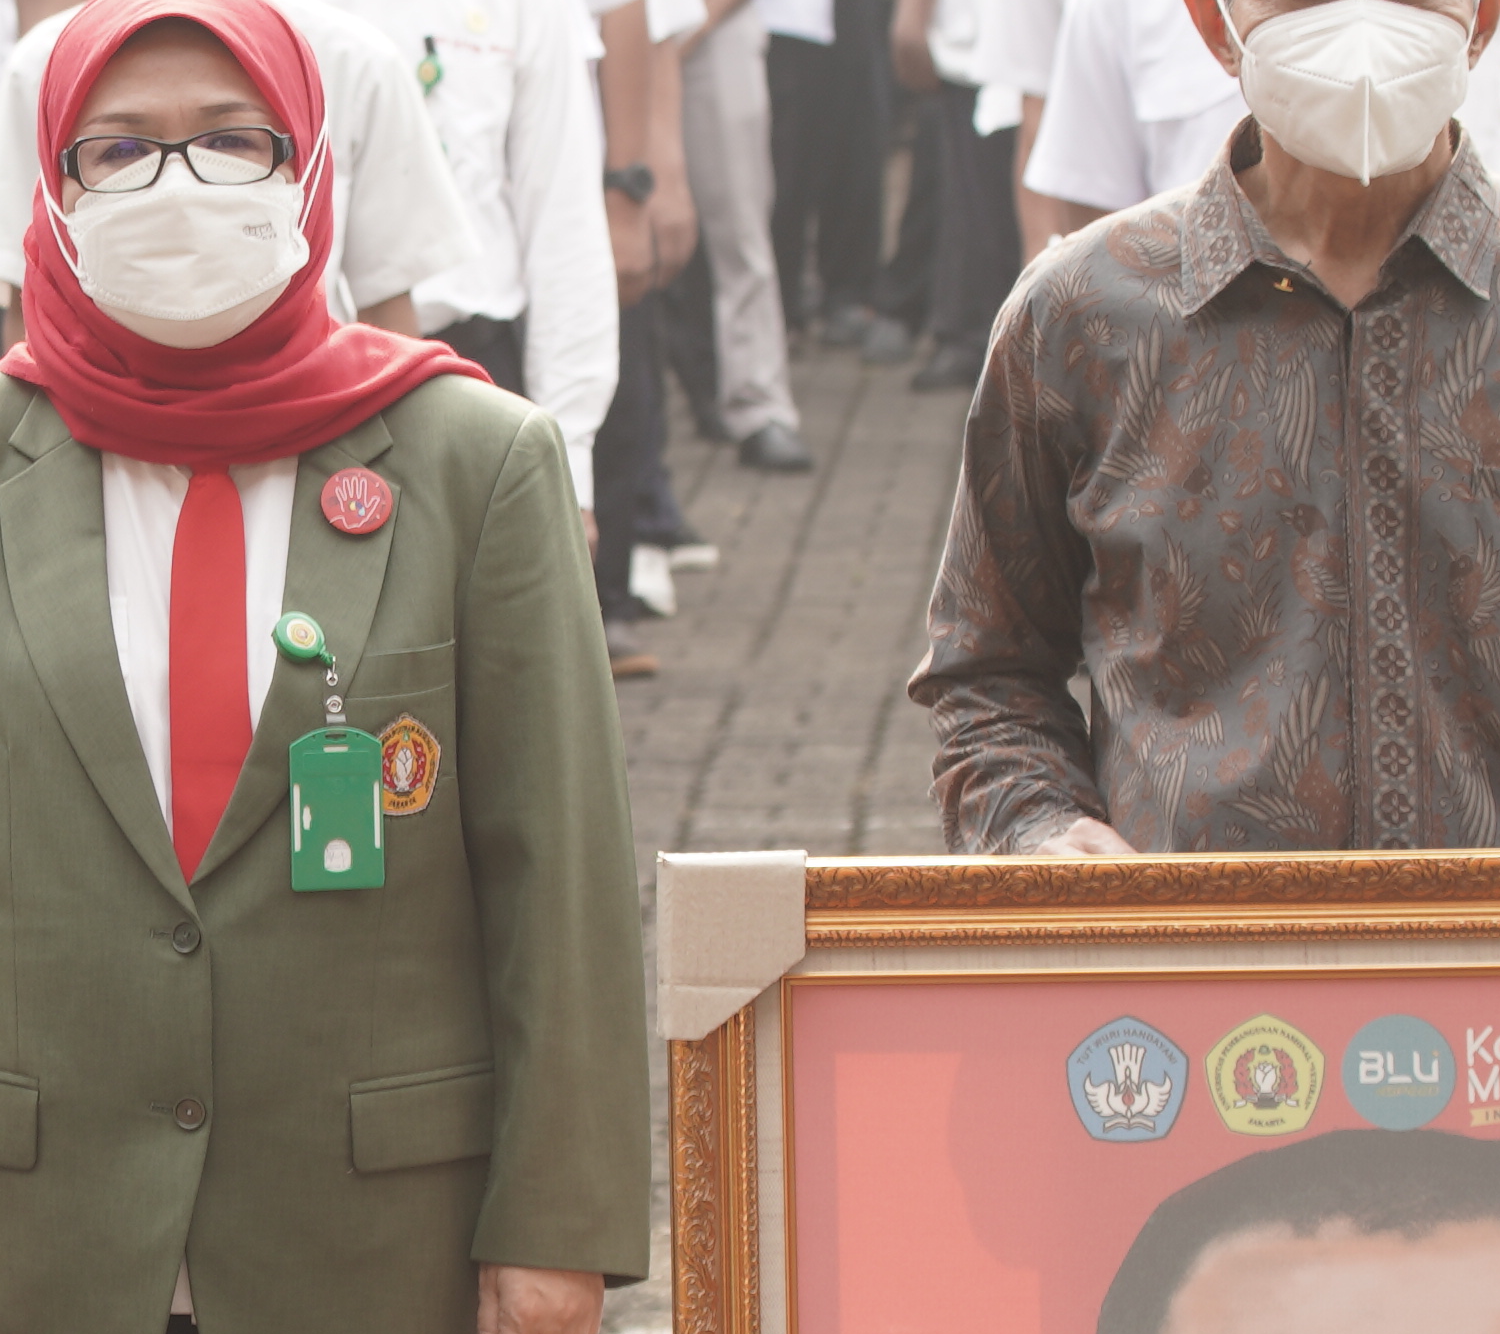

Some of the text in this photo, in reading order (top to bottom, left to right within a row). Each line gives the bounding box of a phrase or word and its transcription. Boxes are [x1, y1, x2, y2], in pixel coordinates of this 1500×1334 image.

[1076, 1047, 1094, 1066] TUT
[1123, 1028, 1178, 1066] HANDAYANI
[1358, 1050, 1440, 1085] BLU
